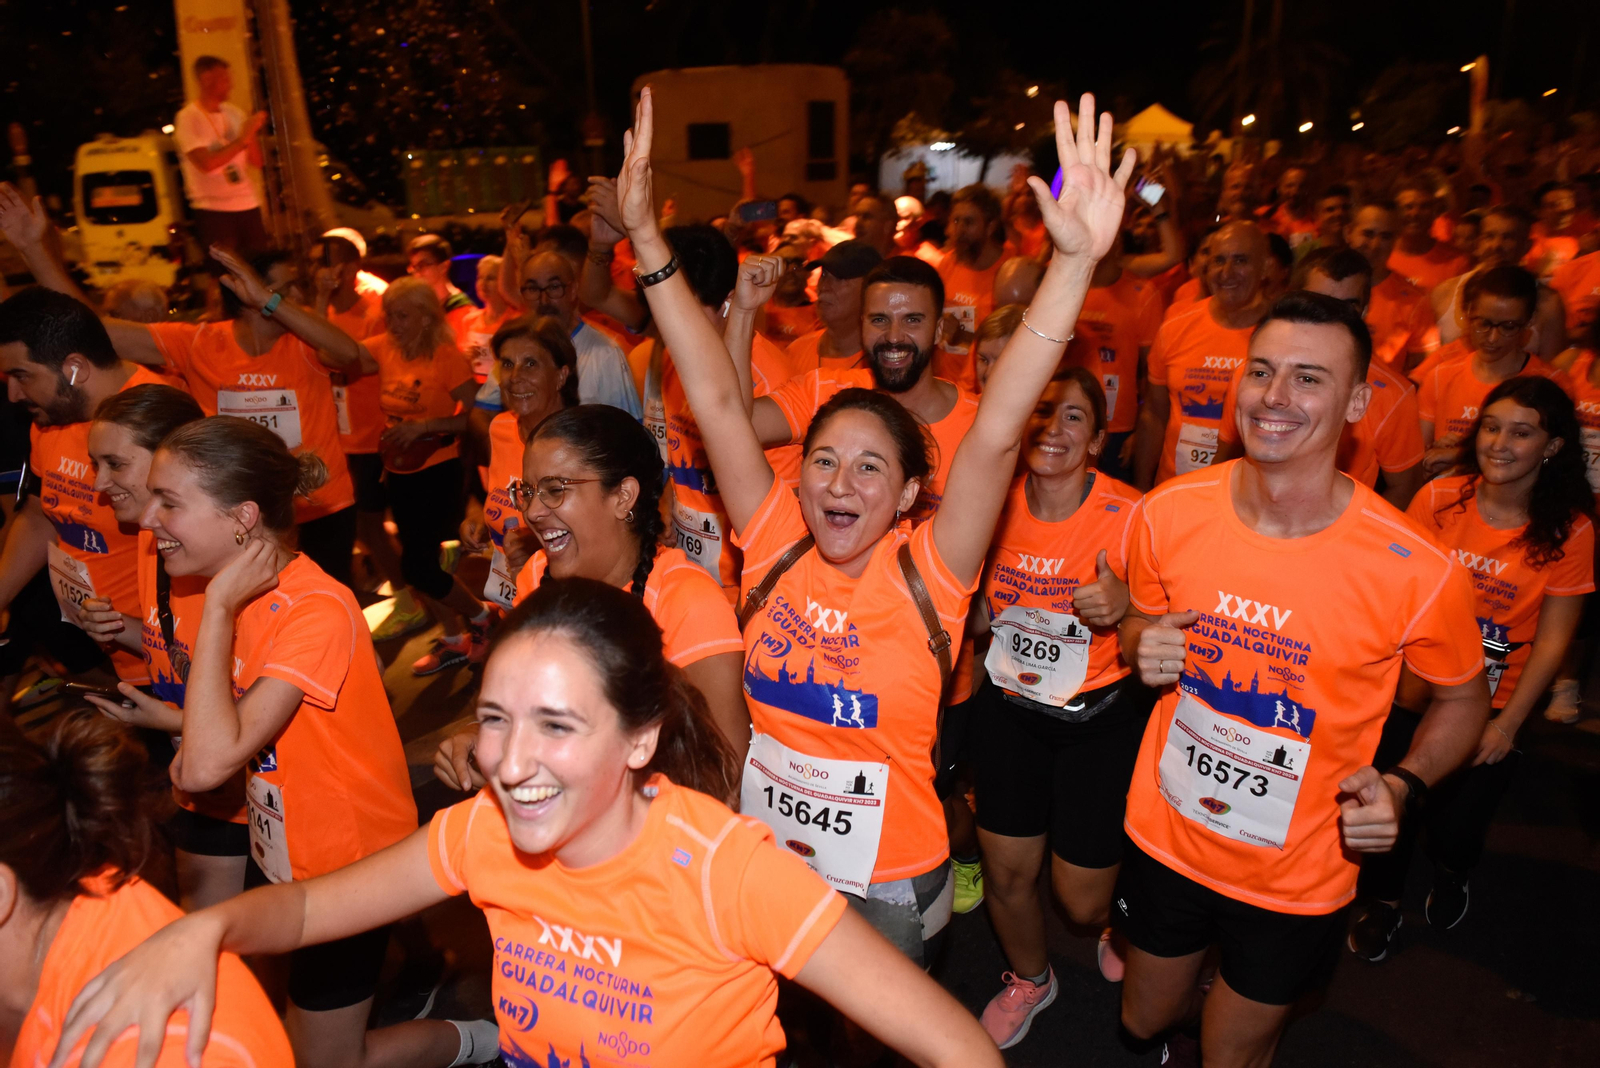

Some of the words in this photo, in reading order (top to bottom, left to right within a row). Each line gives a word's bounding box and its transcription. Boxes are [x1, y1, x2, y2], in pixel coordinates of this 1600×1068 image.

[1202, 356, 1243, 369] XXXV
[237, 373, 277, 387] XXXV
[57, 456, 89, 480] XXXV
[996, 564, 1032, 582] CARRERA
[1016, 553, 1065, 575] XXXV
[1457, 549, 1508, 576] XXXV
[1472, 572, 1518, 592] NOCTURNA
[767, 605, 777, 619] DEL
[775, 596, 817, 643] CARRERA
[1214, 590, 1293, 631] XXXV
[1012, 633, 1061, 663] 9269
[1191, 623, 1309, 666] GUADALQUIVIR
[1242, 625, 1312, 653] NOCTURNA
[1180, 682, 1199, 695] 2023
[1186, 744, 1269, 797] 16573
[1234, 754, 1271, 771] GUADALQUIVIR
[804, 788, 813, 796] DEL
[813, 792, 853, 803] GUADALQUIVIR
[763, 785, 853, 836] 15645
[1239, 829, 1277, 846] Cruzcampo
[826, 874, 864, 889] Cruzcampo
[532, 915, 622, 968] XXXV
[495, 937, 566, 973] CARRERA
[574, 964, 654, 999] NOCTURNA
[501, 961, 653, 1025] GUADALQUIVIR
